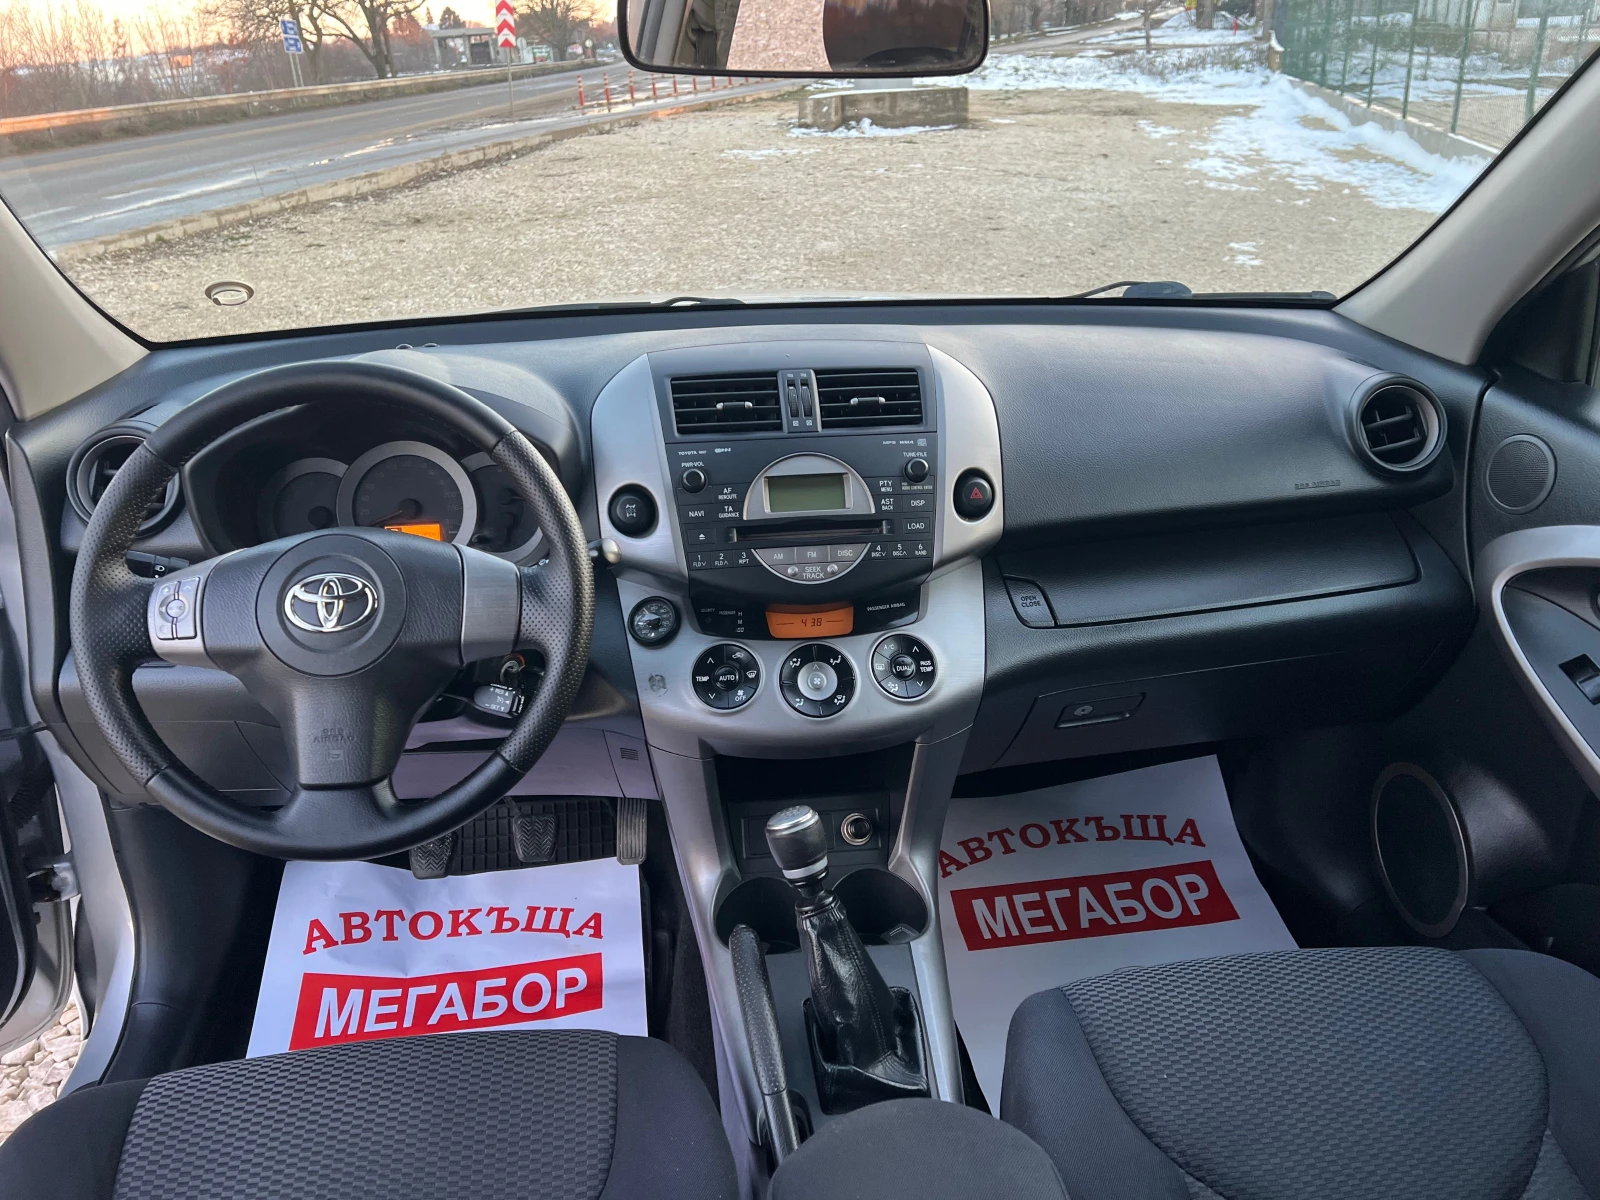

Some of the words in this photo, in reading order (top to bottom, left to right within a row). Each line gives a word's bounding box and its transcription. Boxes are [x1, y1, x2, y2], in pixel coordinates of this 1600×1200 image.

[867, 604, 890, 612] PASSENGER
[938, 814, 1206, 878] АВТОКЪЩА
[302, 905, 604, 956] АВТОКЪЩА
[971, 873, 1210, 940] МЕГАБОР
[314, 967, 588, 1039] МЕГАБОР
